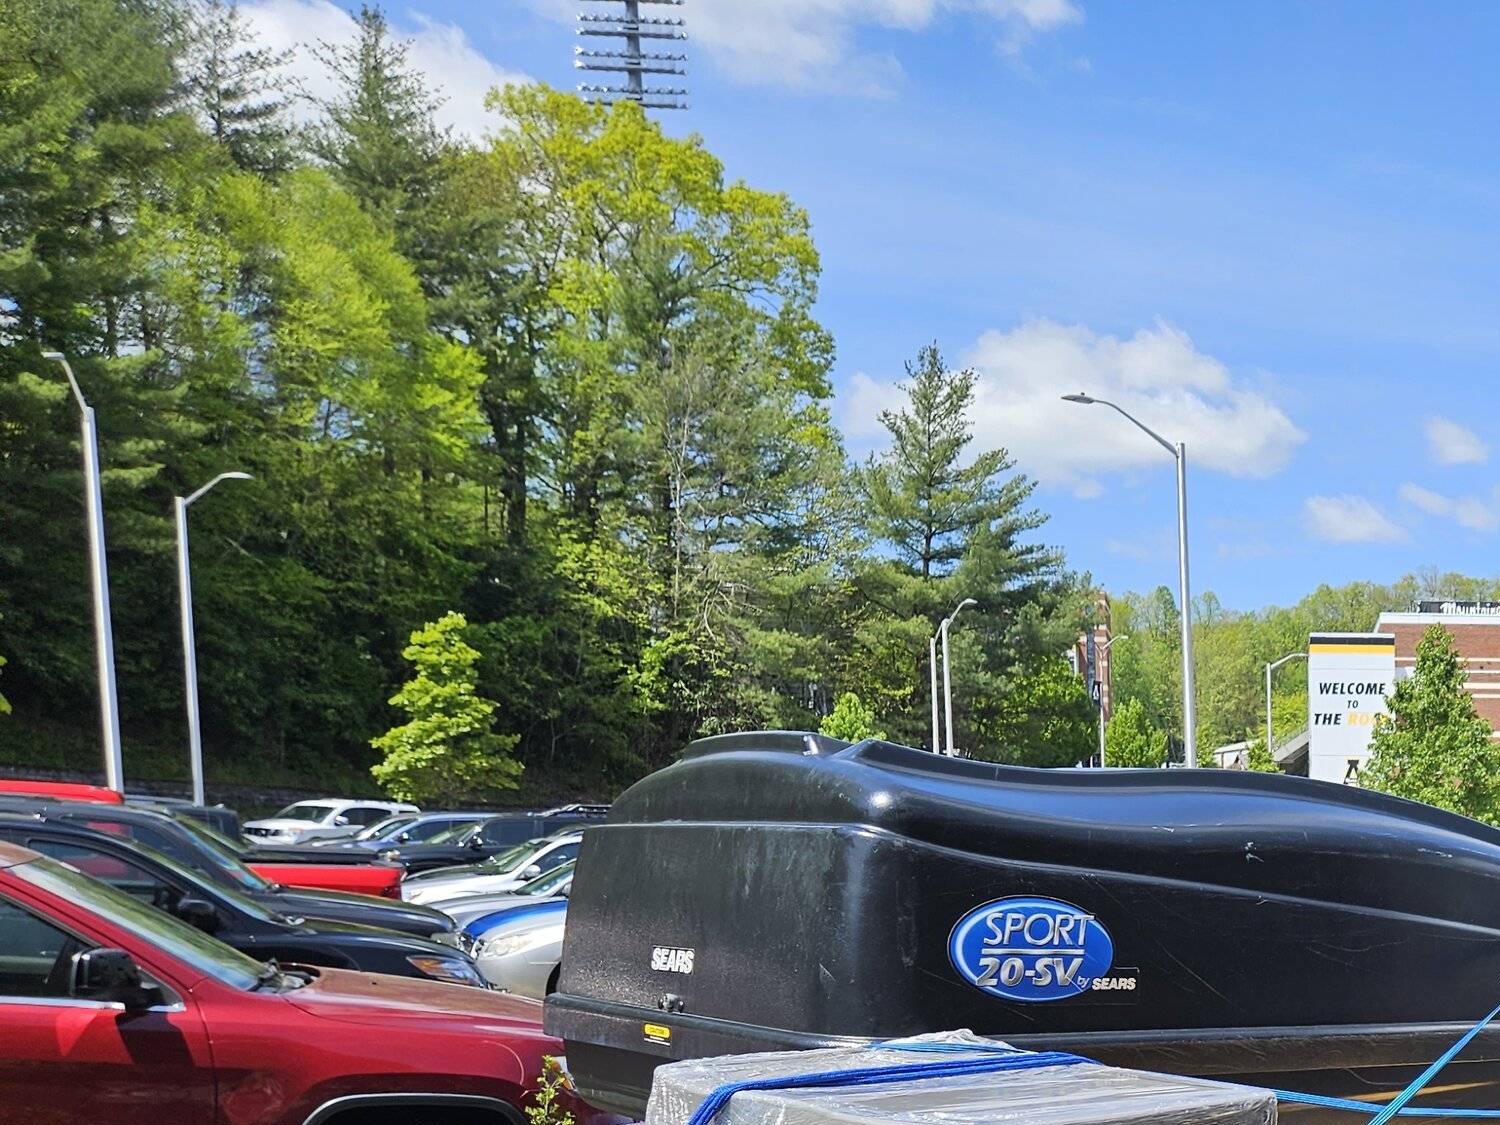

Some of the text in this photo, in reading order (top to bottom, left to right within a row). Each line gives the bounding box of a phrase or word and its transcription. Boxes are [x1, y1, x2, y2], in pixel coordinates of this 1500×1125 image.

[1319, 682, 1386, 695] WELCOME
[1347, 700, 1359, 709] TO
[1314, 713, 1341, 725] THE
[983, 912, 1095, 946] SPORT
[651, 947, 695, 974] SEARS
[975, 957, 1084, 987] 20-SV
[1077, 976, 1137, 990] by SEARS
